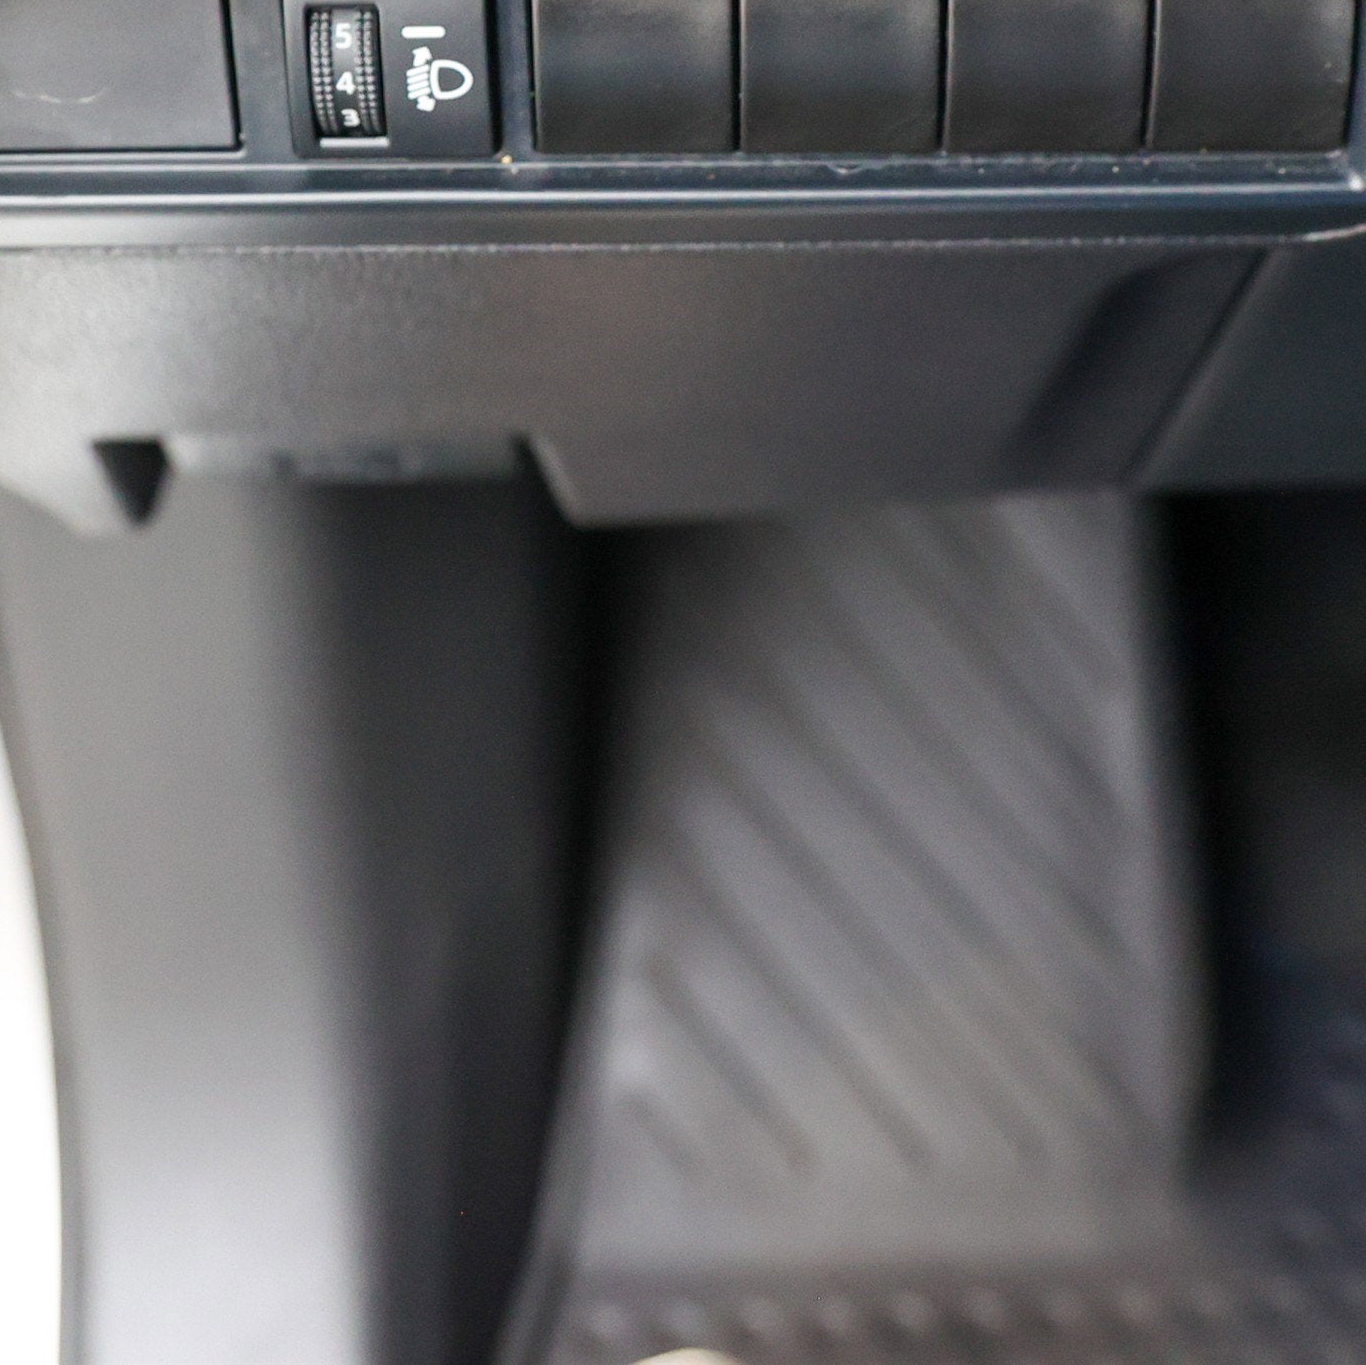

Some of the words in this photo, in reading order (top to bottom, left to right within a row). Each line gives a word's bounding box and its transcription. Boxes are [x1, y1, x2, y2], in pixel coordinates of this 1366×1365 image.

[335, 22, 353, 49] 5
[336, 71, 356, 95] 4
[341, 108, 360, 127] 3
